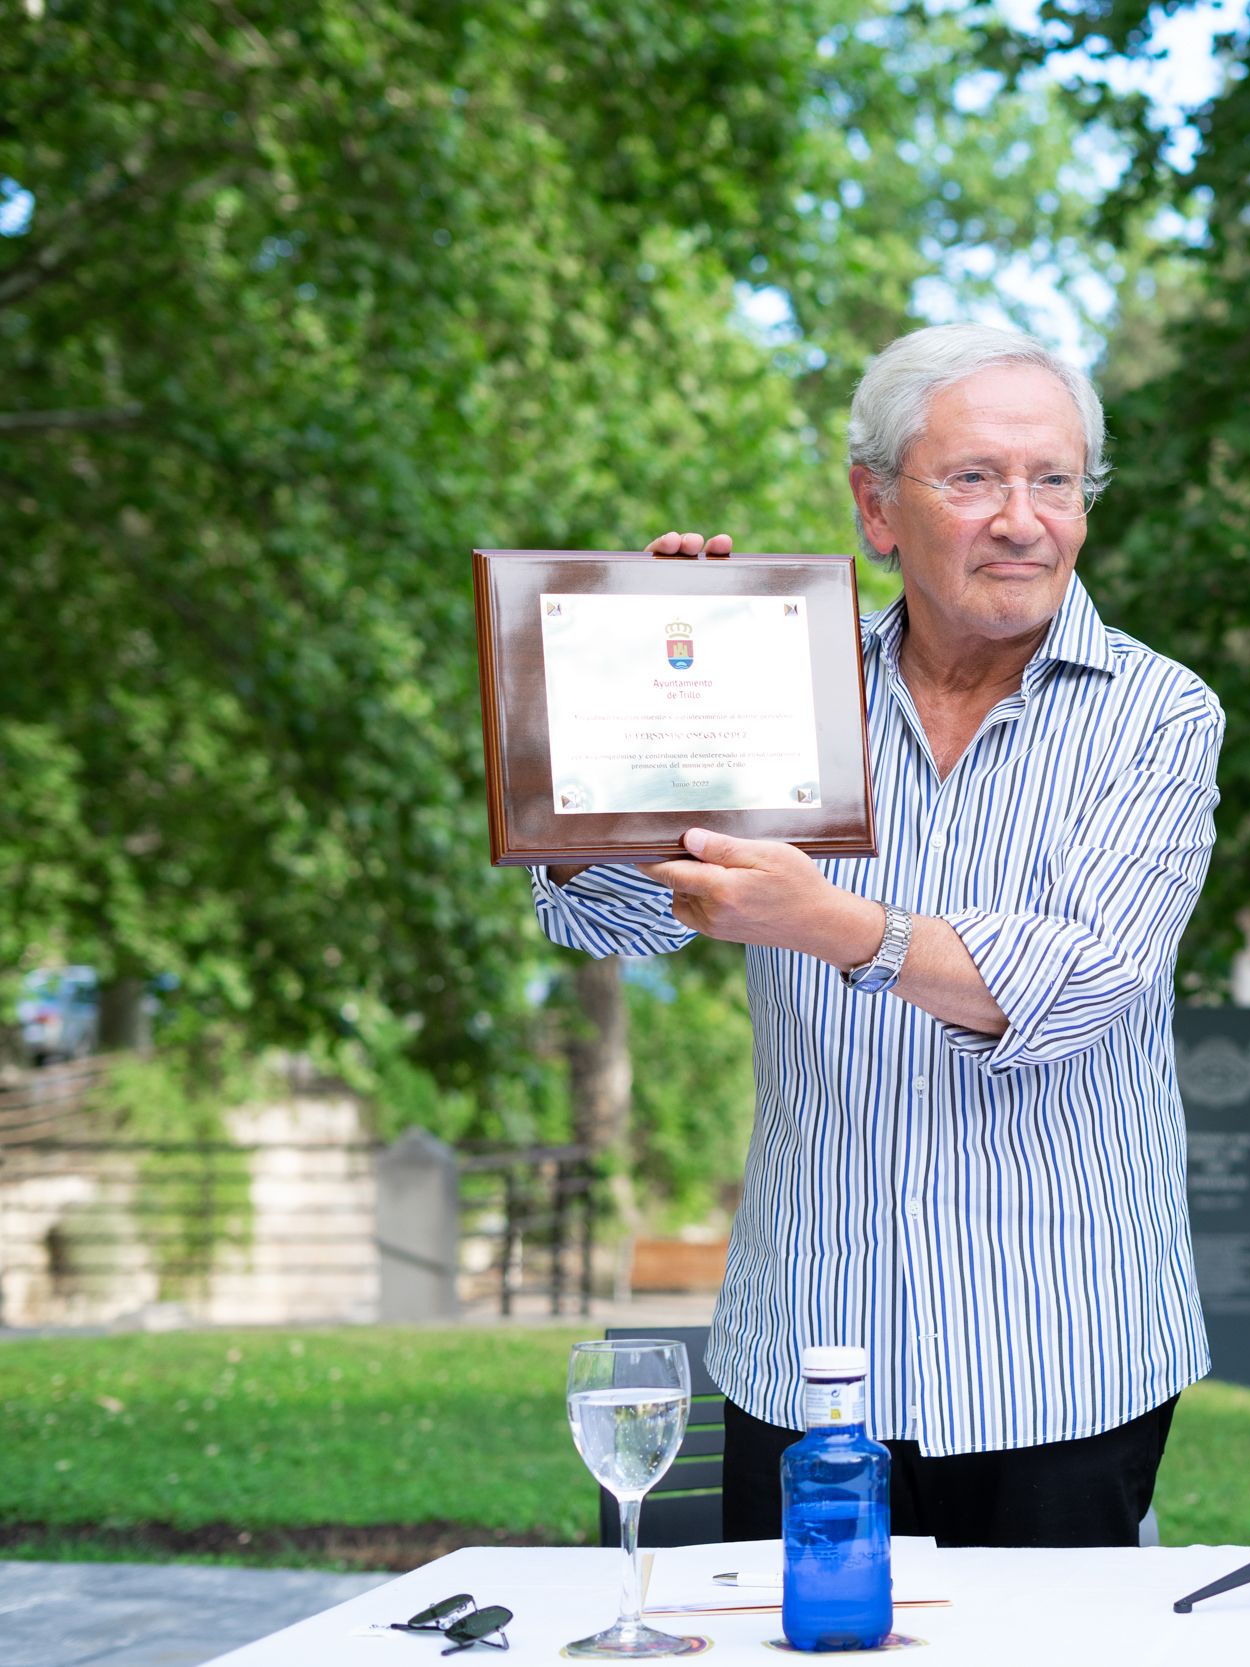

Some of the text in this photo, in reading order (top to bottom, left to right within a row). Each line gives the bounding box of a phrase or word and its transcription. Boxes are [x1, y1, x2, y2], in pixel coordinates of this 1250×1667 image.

[653, 679, 713, 689] Ayuntamiento
[666, 690, 701, 699] de Trillo
[669, 760, 680, 769] del
